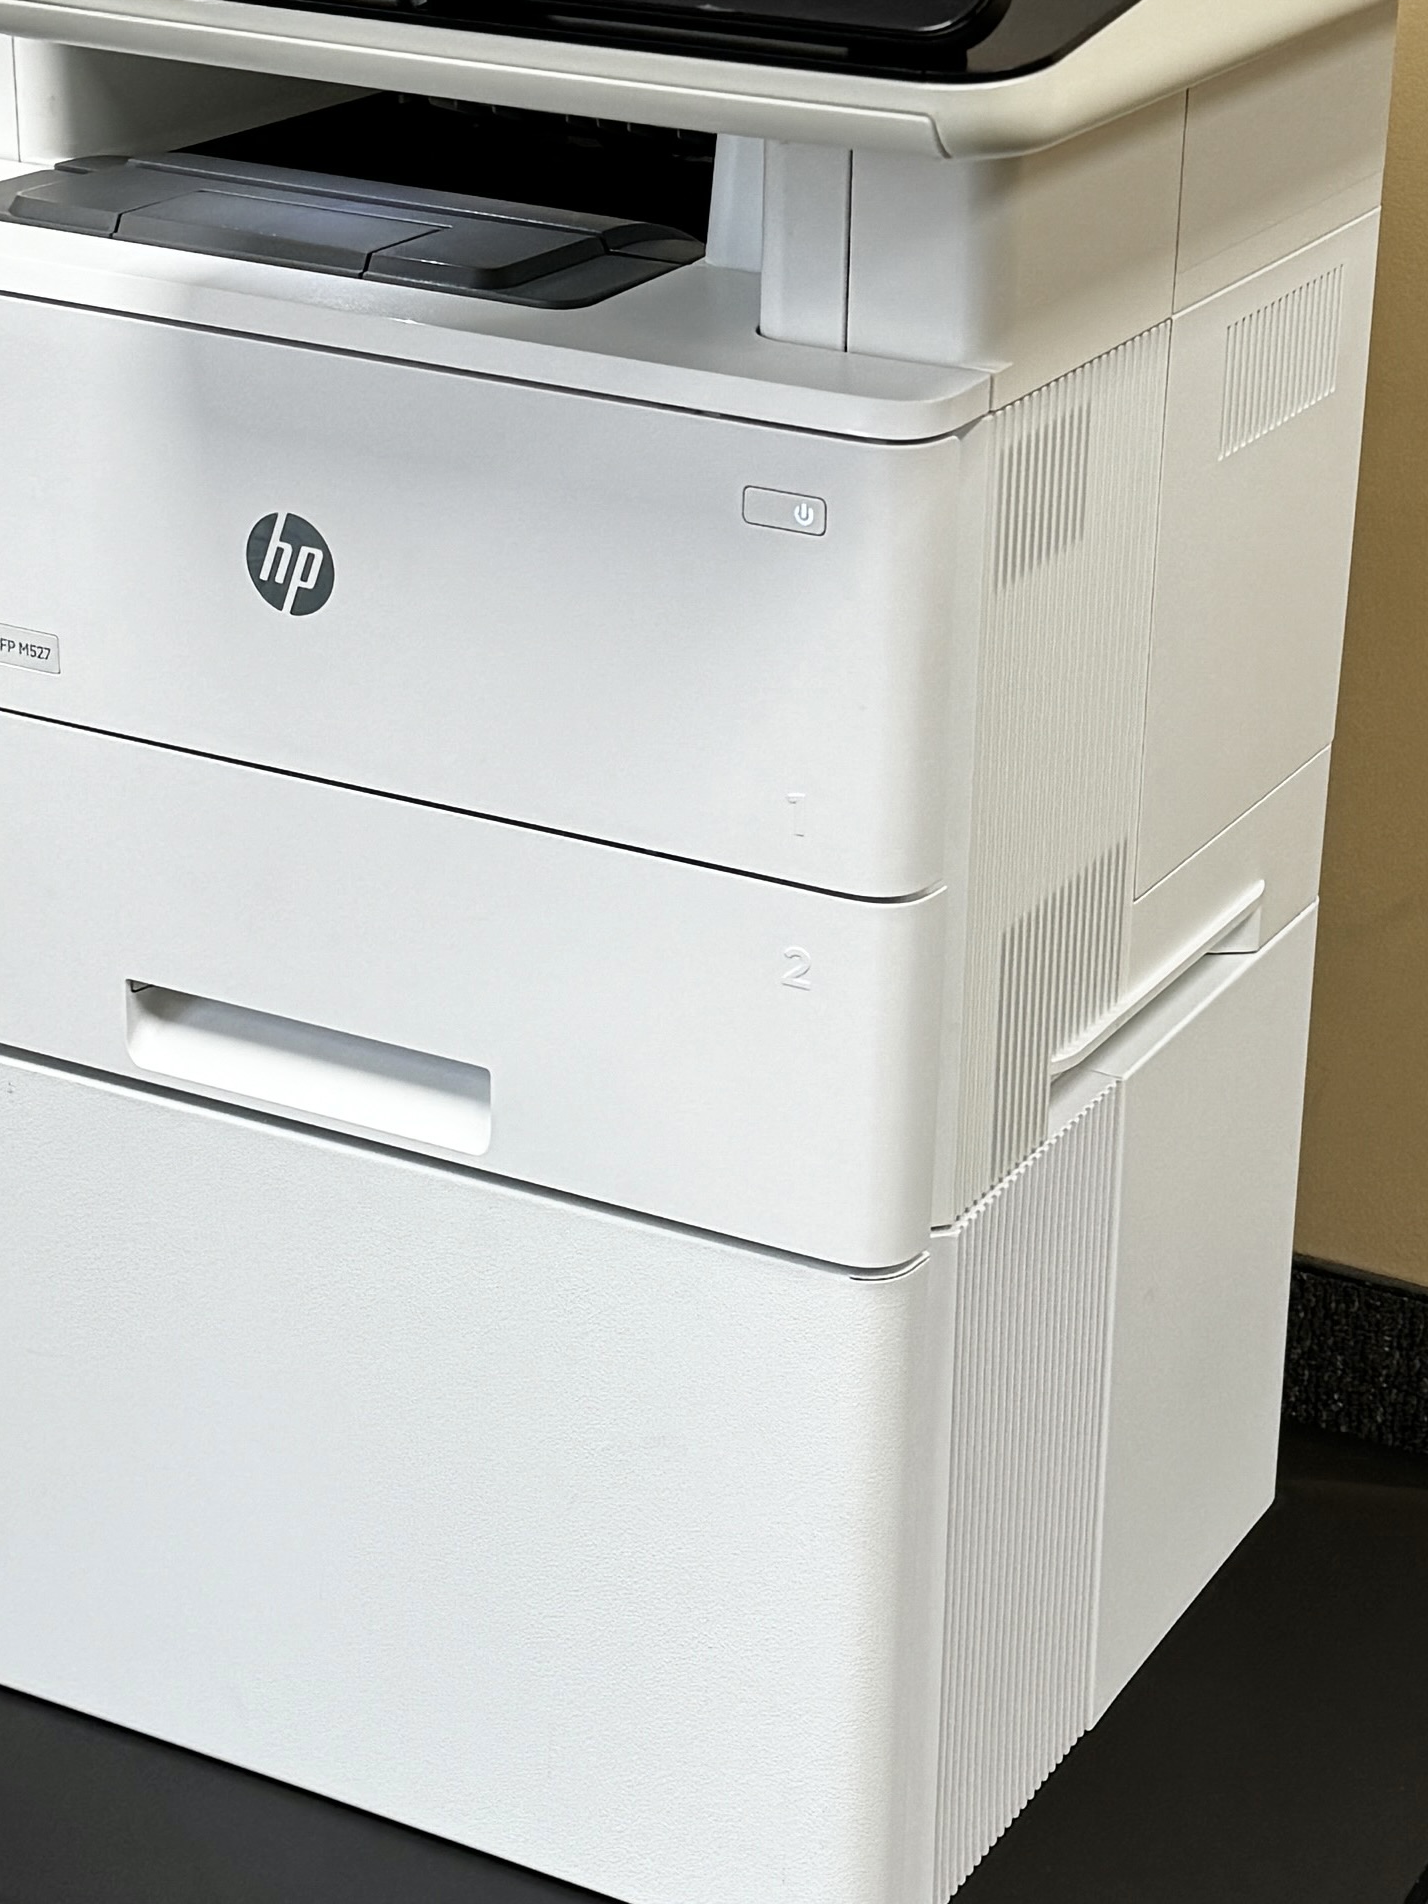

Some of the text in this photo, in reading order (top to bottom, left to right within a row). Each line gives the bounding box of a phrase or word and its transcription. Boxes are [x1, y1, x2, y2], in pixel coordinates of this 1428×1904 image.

[252, 512, 329, 615] hp
[18, 642, 51, 661] M527
[786, 792, 806, 838] 1
[781, 945, 812, 991] 2
